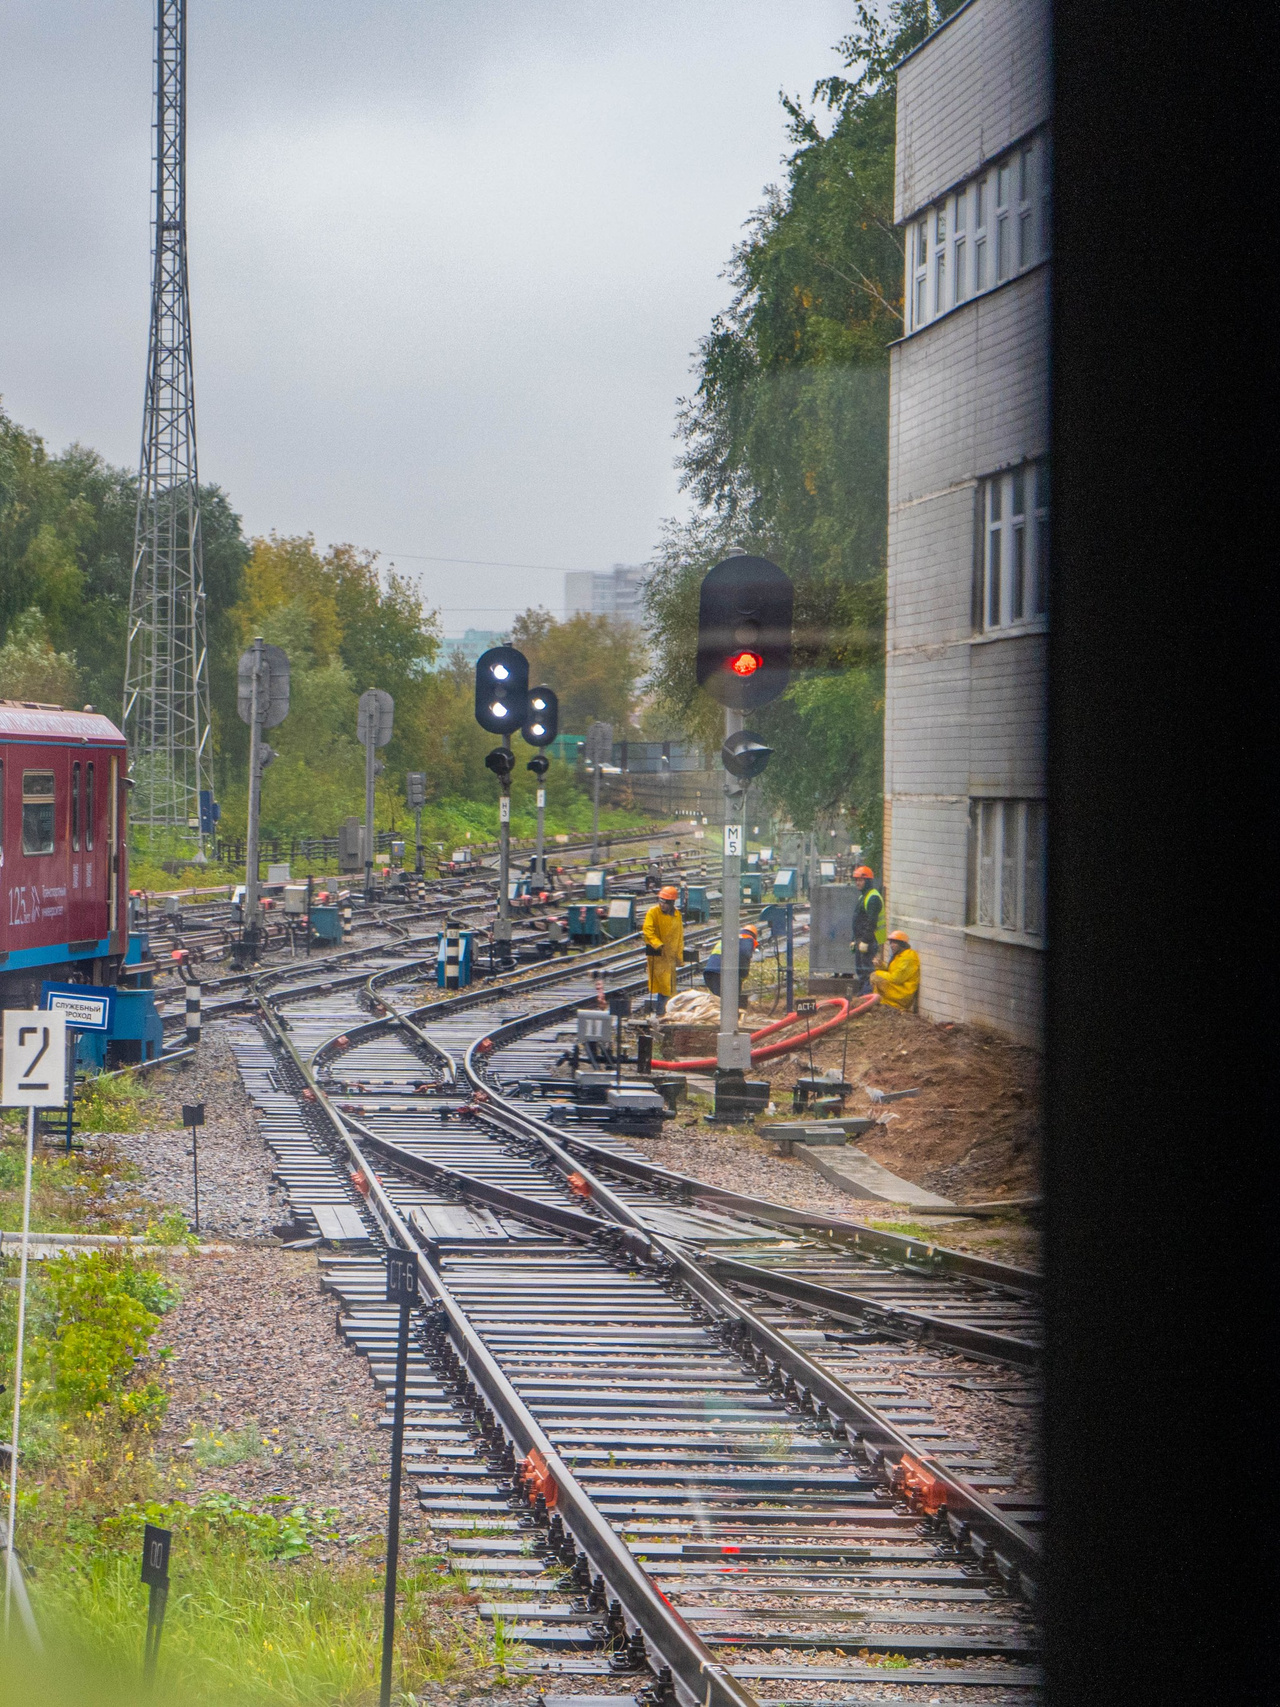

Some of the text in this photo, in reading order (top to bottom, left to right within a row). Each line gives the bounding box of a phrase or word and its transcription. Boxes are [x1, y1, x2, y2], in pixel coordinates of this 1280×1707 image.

[729, 841, 737, 853] 5
[55, 1001, 101, 1013] СЛУЖЕБНЫЙ
[18, 1026, 50, 1090] 2
